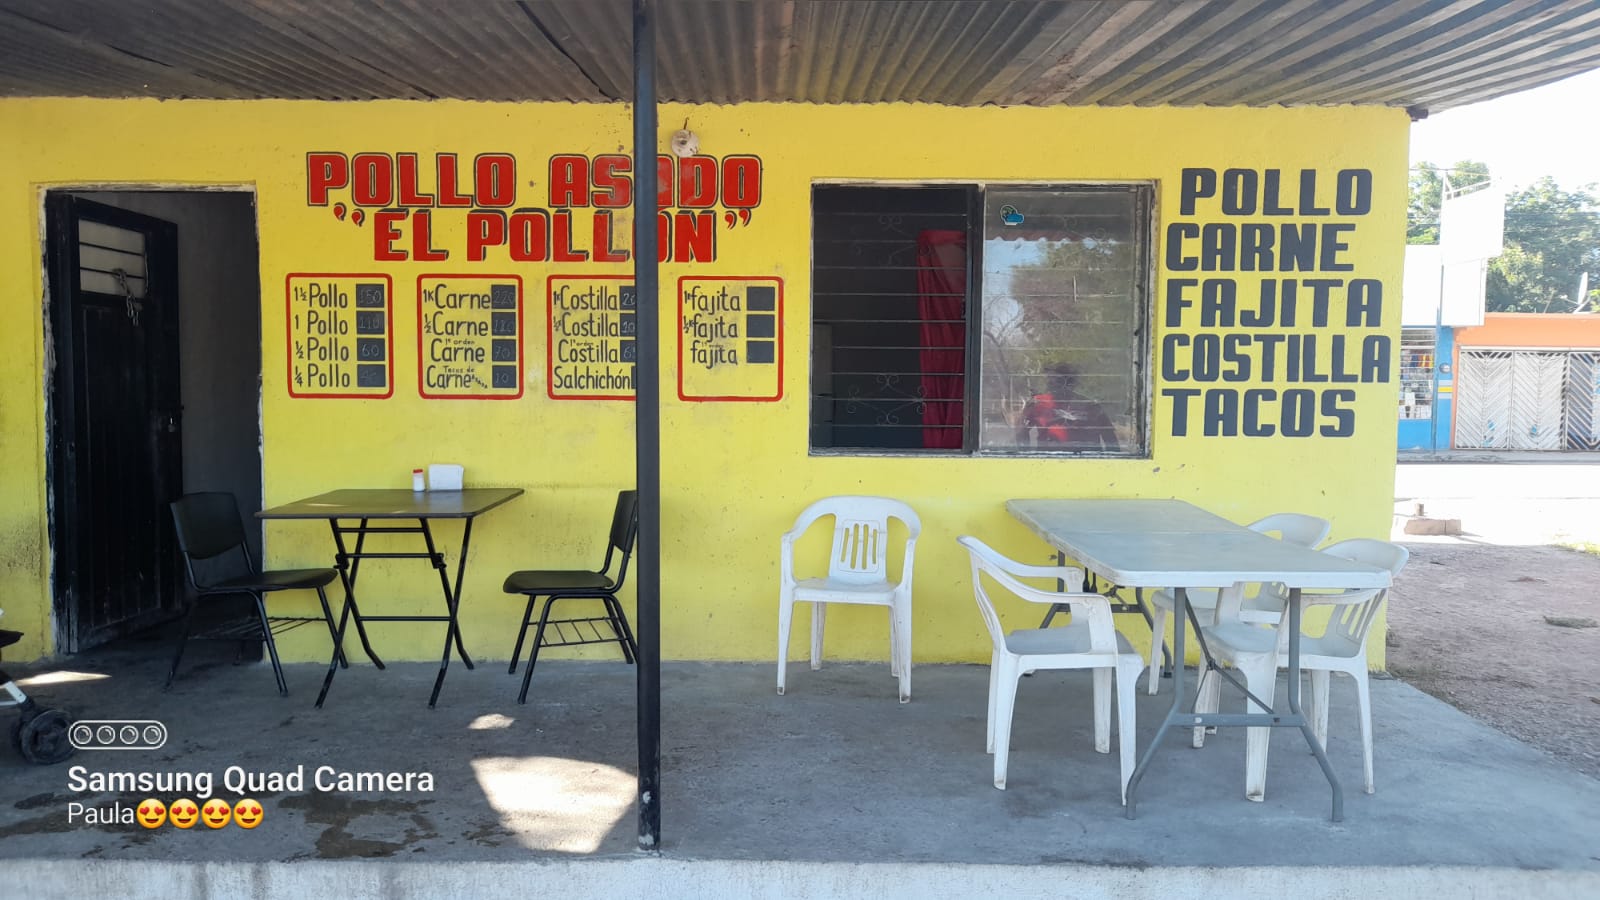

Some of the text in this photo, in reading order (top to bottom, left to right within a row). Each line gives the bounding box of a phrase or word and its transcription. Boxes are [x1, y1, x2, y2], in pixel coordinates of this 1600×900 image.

[306, 152, 517, 208] POLLO
[1180, 168, 1373, 216] POLLO
[1165, 222, 1356, 272] CARNE
[309, 283, 348, 308] Pollo
[435, 283, 491, 309] Carne
[560, 285, 618, 311] Costilla
[691, 286, 741, 315] fajita
[1165, 278, 1383, 328] FAJITA
[294, 314, 299, 330] 1
[307, 310, 348, 335] Pollo
[432, 311, 489, 336] Carne
[562, 312, 619, 337] Costilla
[692, 313, 738, 343] fajita
[307, 337, 349, 361] Pollo
[431, 338, 485, 363] Carne
[558, 339, 619, 363] Costilla
[690, 340, 738, 369] fajita
[1162, 333, 1391, 383] COSTILLA
[307, 363, 350, 387] Pollo
[426, 365, 471, 389] Carne
[554, 365, 631, 390] Salchichón
[1162, 388, 1356, 438] TACOS
